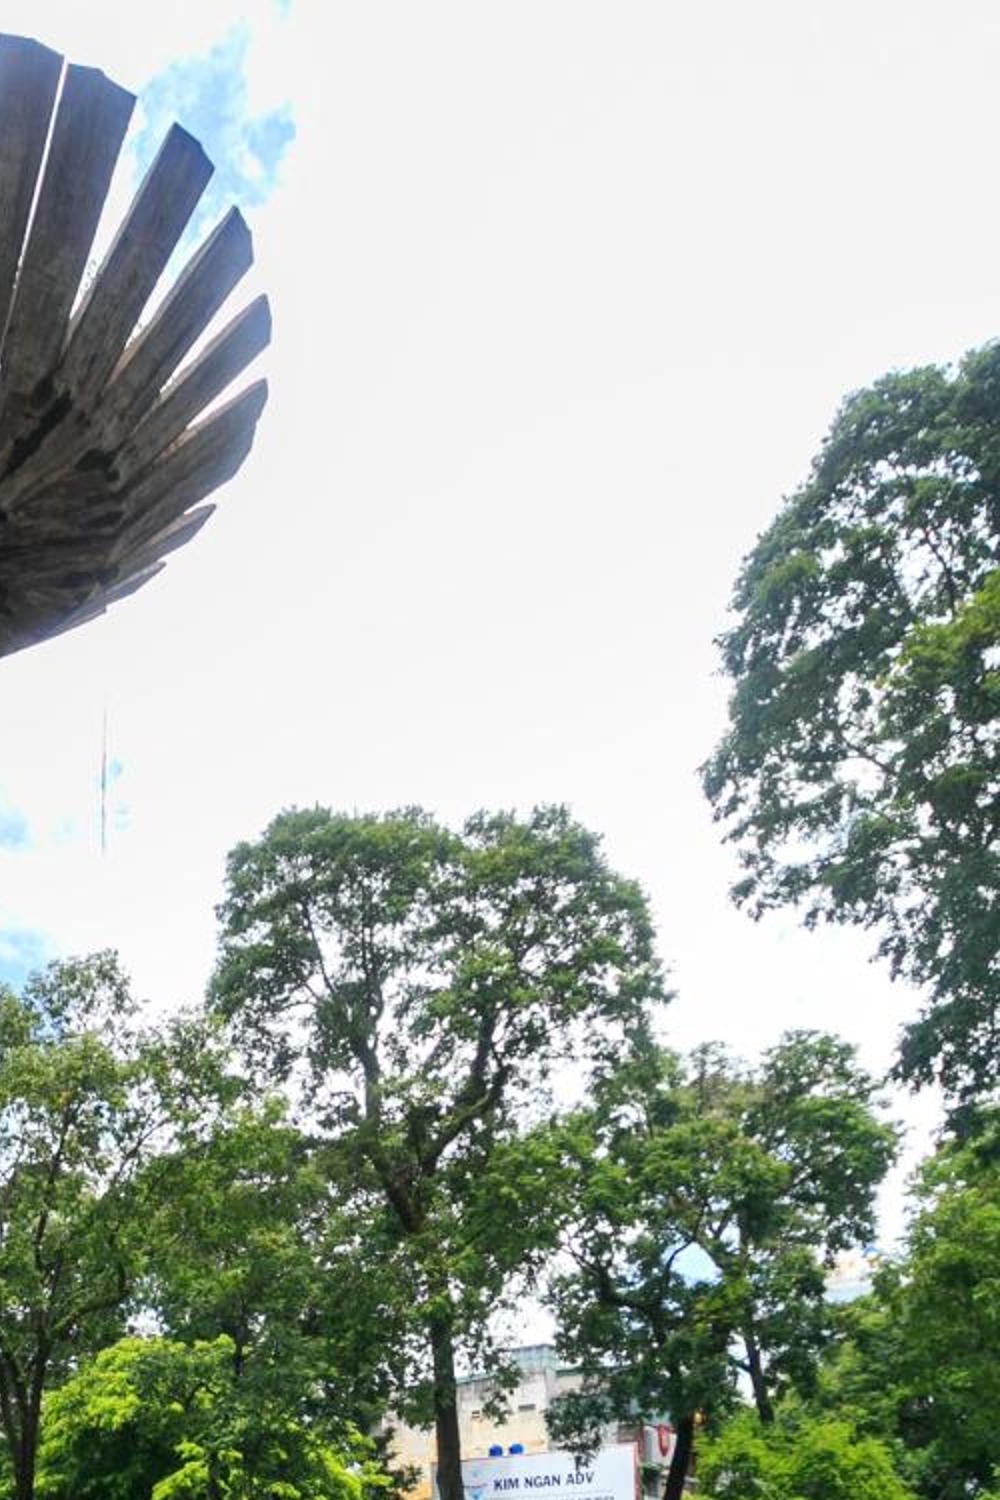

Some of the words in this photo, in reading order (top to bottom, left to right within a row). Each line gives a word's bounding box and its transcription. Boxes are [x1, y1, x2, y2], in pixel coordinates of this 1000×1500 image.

[494, 1478, 519, 1491] KIM
[524, 1474, 561, 1489] NGAN
[565, 1471, 595, 1486] ADV
